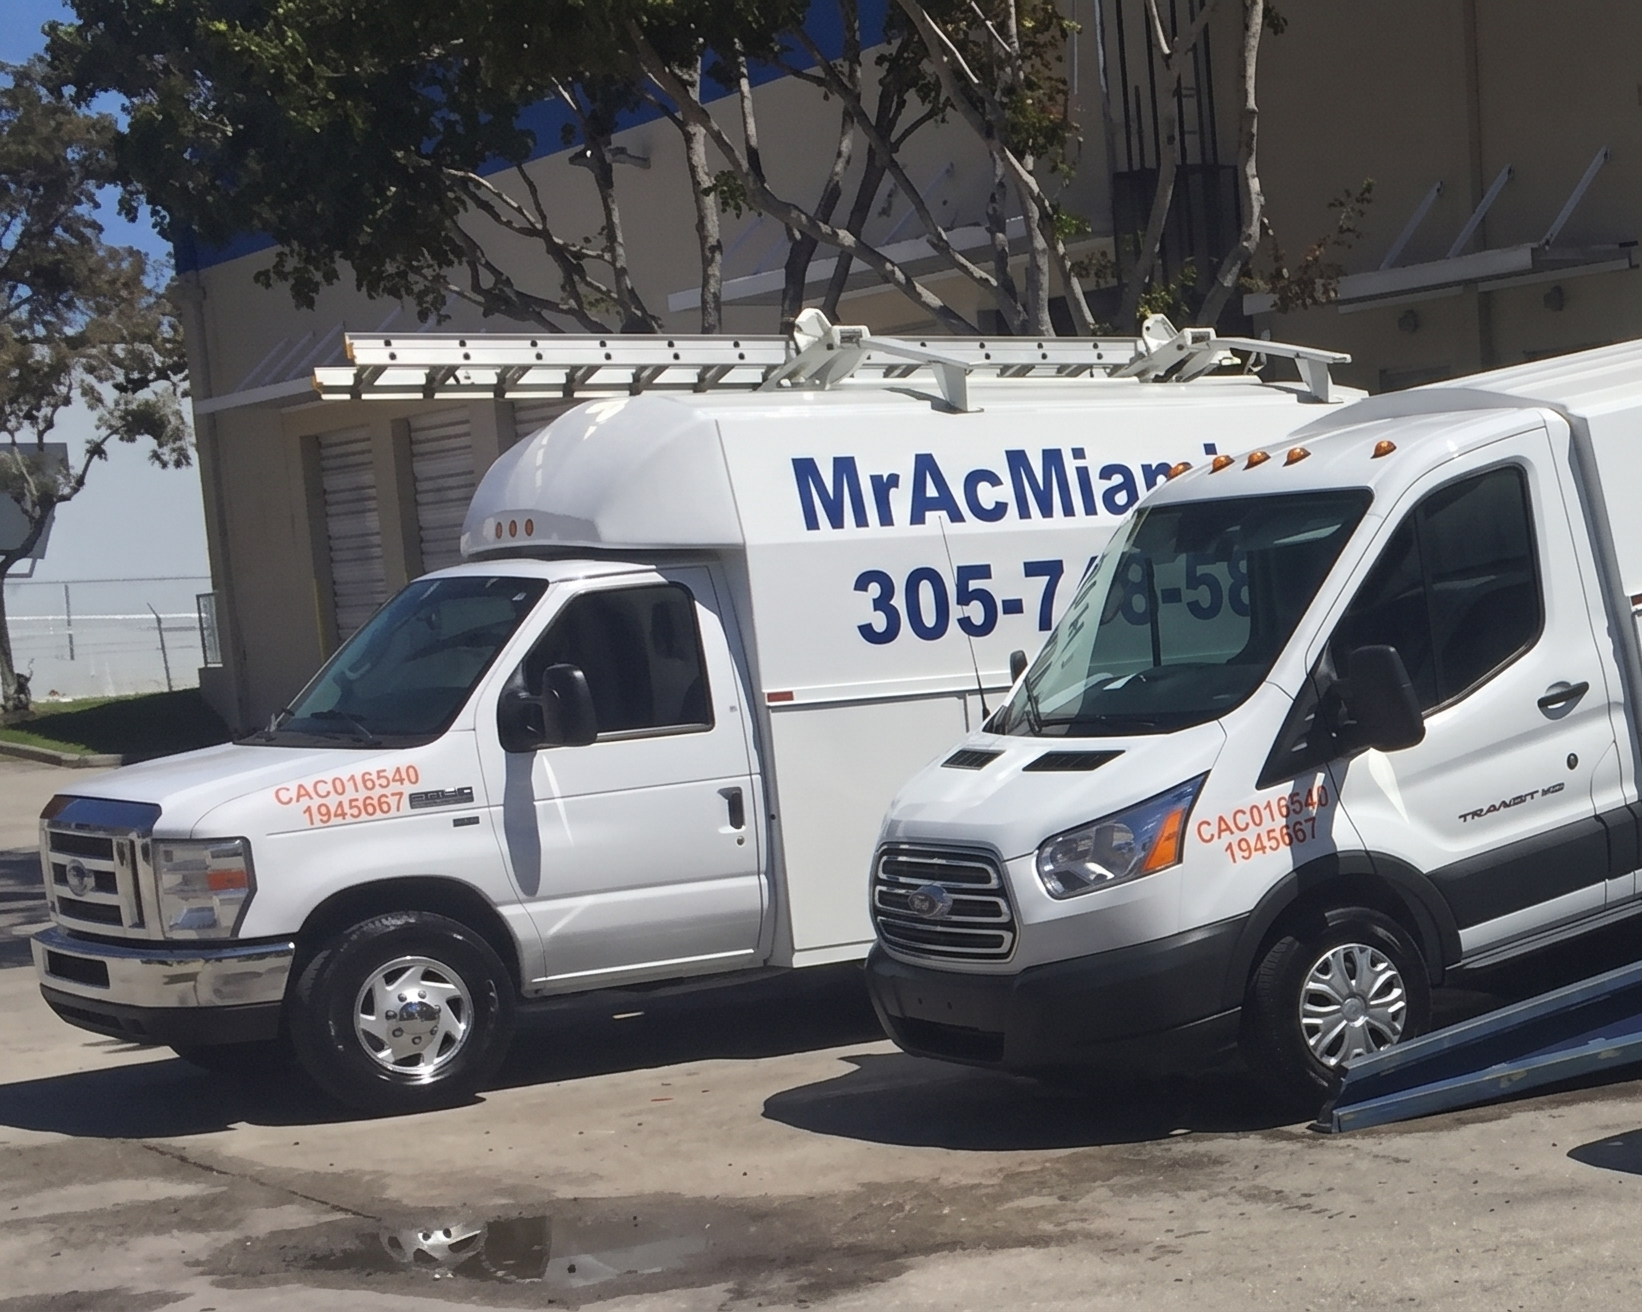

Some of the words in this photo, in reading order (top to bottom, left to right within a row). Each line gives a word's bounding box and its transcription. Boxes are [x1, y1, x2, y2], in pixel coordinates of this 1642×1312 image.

[274, 764, 420, 806] CAC016540
[303, 791, 405, 826] 1945667
[1196, 784, 1329, 844] CAC016540
[1224, 816, 1317, 864] 1945667
